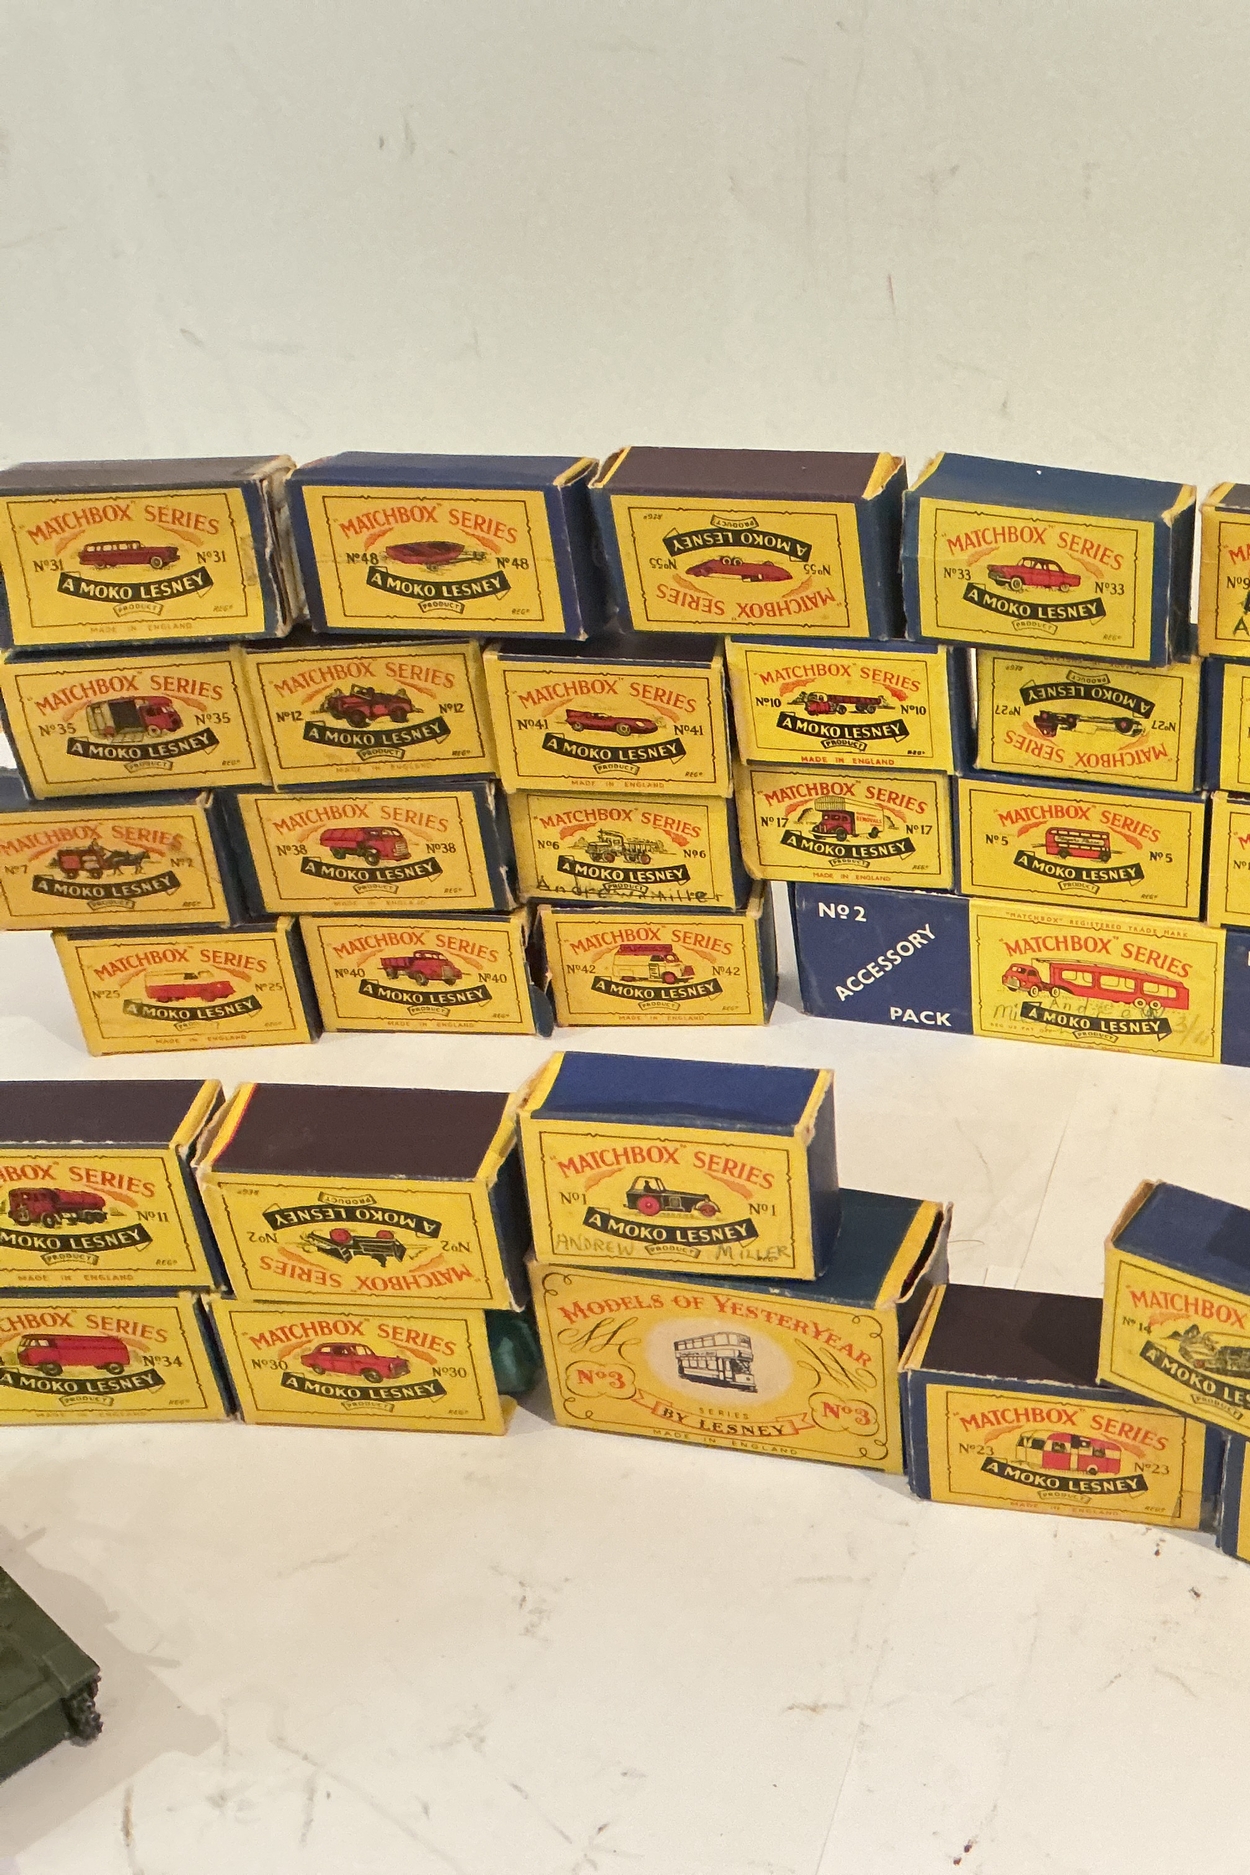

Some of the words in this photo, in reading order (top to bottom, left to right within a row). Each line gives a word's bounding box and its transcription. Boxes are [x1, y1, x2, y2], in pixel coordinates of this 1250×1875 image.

[144, 506, 219, 536] SERIES
[1059, 531, 1123, 571] SERIES
[388, 578, 436, 596] MOKO
[442, 576, 501, 596] LESNEY
[655, 584, 725, 615] SERIES
[385, 662, 455, 689] SERIES
[861, 667, 921, 692] SERIES
[1027, 689, 1086, 705] LESNEY
[1092, 688, 1134, 706] MOKO
[88, 745, 141, 759] MOKO
[147, 734, 211, 759] LESNEY
[561, 742, 610, 761] MOKO
[619, 741, 678, 761] LESNEY
[867, 785, 928, 814] SERIES
[380, 805, 449, 832] SERIES
[575, 864, 624, 881] MOKO
[630, 869, 684, 882] LESNEY
[1032, 861, 1076, 879] MOKO
[1083, 866, 1138, 880] LESNEY
[52, 883, 103, 898] MOKO
[108, 877, 171, 898] LESNEY
[1070, 920, 1122, 930] REGISTERED
[1128, 925, 1156, 933] TRADE
[1164, 929, 1188, 937] MARK
[835, 923, 936, 1001] ACCESSORY
[1121, 943, 1193, 977] SERIES
[378, 986, 423, 1003] MOKO
[428, 988, 484, 1004] LESNEY
[609, 985, 655, 999] MOKO
[659, 982, 715, 999] LESNEY
[143, 1005, 192, 1020] MOKO
[198, 1001, 255, 1020] LESNEY
[890, 1007, 952, 1026] PACK
[1043, 1013, 1091, 1029] MOKO
[1100, 1020, 1161, 1033] LESNEY
[693, 1151, 775, 1189] SERIES
[275, 1210, 348, 1226] LESNEY
[357, 1209, 417, 1229] MOKO
[1, 1233, 59, 1250] MOKO
[70, 1227, 141, 1250] LESNEY
[557, 1294, 664, 1324] MODELS
[672, 1294, 703, 1309] OF
[86, 1313, 168, 1342] SERIES
[378, 1324, 456, 1356] SERIES
[662, 1407, 687, 1424] BY
[700, 1419, 786, 1437] LESNEY
[699, 1407, 749, 1419] SERIES
[653, 1429, 689, 1440] MADE
[730, 1440, 798, 1455] ENGLAND
[1005, 1469, 1059, 1488] MOKO
[1069, 1475, 1138, 1492] LESNEY
